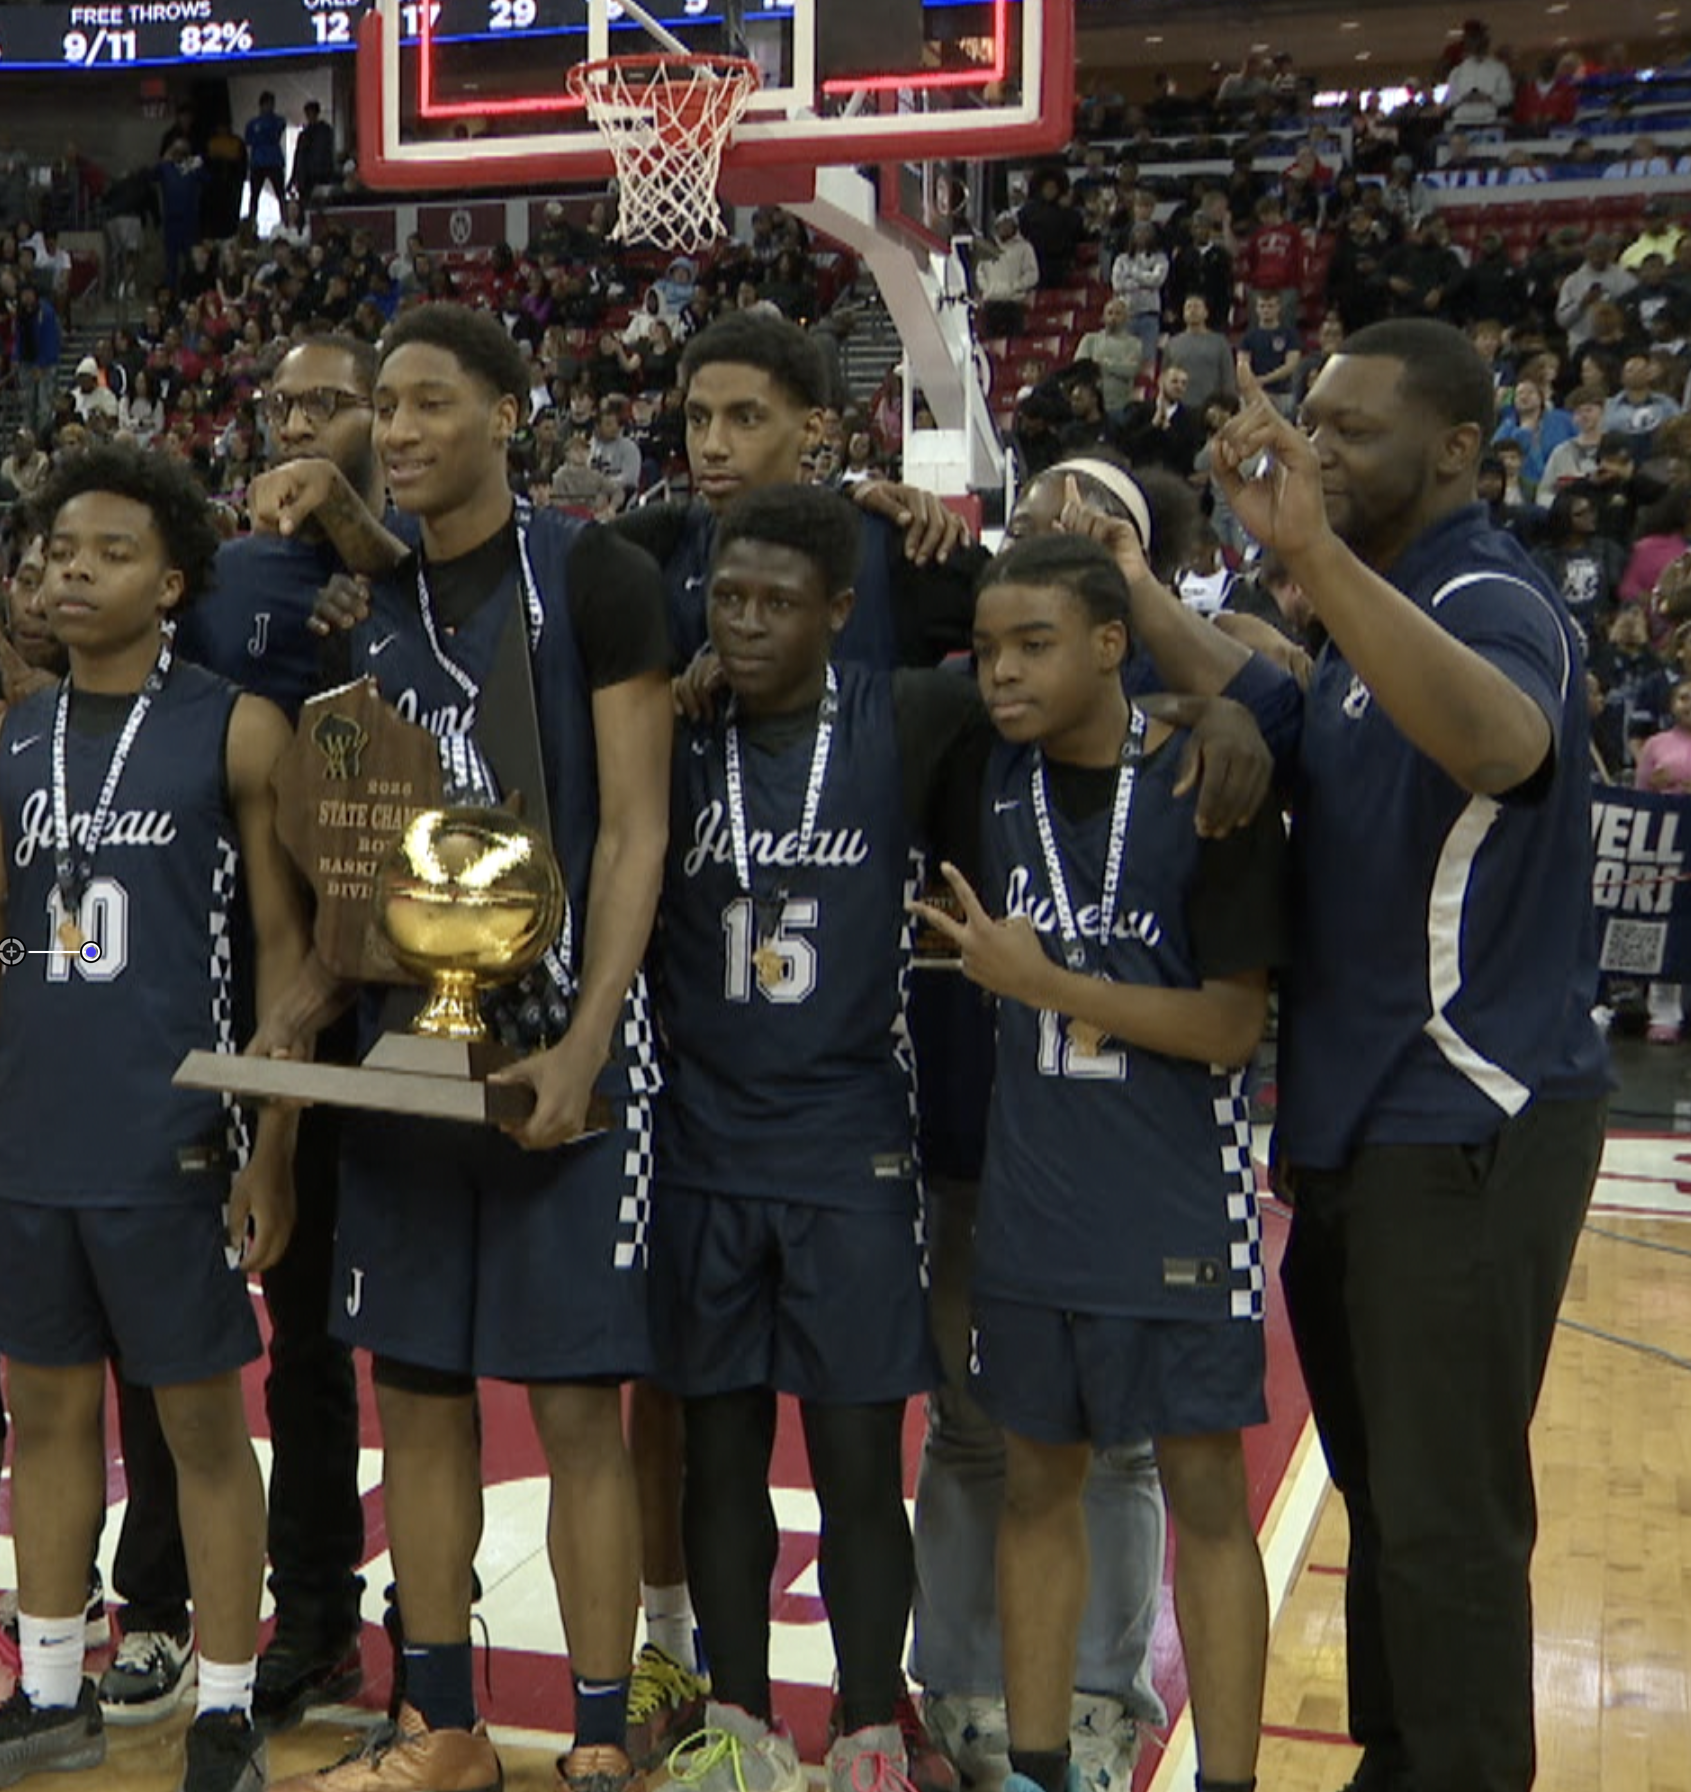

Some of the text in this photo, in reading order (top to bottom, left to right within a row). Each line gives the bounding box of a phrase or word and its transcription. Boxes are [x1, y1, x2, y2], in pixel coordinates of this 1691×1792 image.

[63, 29, 137, 67] 9/11
[179, 20, 253, 55] 82%
[311, 12, 350, 43] 12
[489, 0, 536, 29] 29
[71, 1, 211, 25] FREE THROWS
[248, 612, 271, 656] J
[318, 800, 367, 828] STATE
[328, 881, 373, 899] DIVI
[46, 875, 129, 982] 10
[721, 898, 818, 1003] 15
[346, 1267, 365, 1317] J
